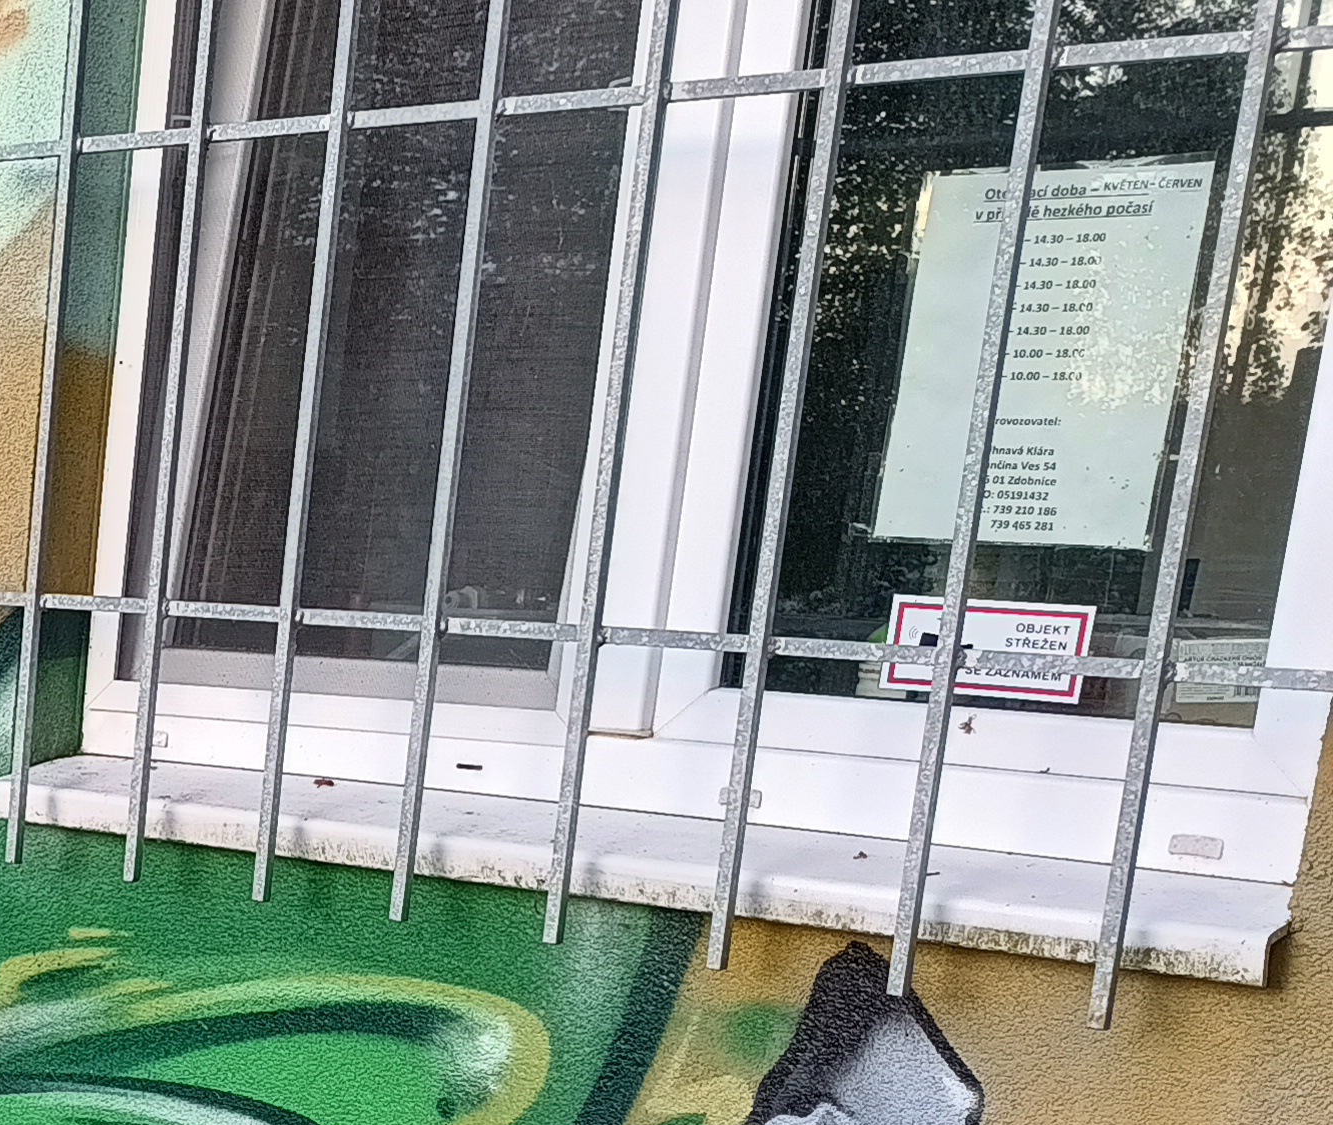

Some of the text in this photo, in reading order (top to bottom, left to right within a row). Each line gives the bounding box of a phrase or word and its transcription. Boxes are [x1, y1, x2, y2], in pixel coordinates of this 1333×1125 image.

[1052, 184, 1087, 198] doba
[1159, 177, 1203, 190] ČERVEN
[975, 211, 984, 221] v
[1043, 203, 1103, 218] hezkého
[1106, 200, 1155, 219] počasí
[1033, 234, 1064, 244] 14.30
[1076, 233, 1106, 243] 18.00
[1029, 257, 1059, 267] 14.30
[1070, 256, 1102, 266] 18.00
[1023, 280, 1053, 290] 14.30
[1065, 279, 1096, 289] 18.00
[1019, 303, 1049, 313] 14.30
[1062, 302, 1093, 312] 18.00
[1016, 326, 1047, 335] 14.30
[1059, 326, 1090, 335] 18.00
[1013, 349, 1043, 358] 10.00
[1009, 371, 1040, 381] 10.00
[994, 416, 1062, 426] rovozovatel:
[1026, 446, 1054, 456] Klára
[990, 460, 1057, 471] nčina Ves 54
[992, 475, 1005, 485] 01
[1008, 476, 1057, 486] Zdobnice
[997, 490, 1049, 501] 05191432
[993, 505, 1013, 514] 739
[1015, 506, 1035, 515] 210
[1037, 507, 1057, 516] 186
[990, 520, 1054, 531] 739 465 281
[1015, 622, 1071, 635] OBJEKT
[1005, 637, 1068, 651] STŘEŽEN
